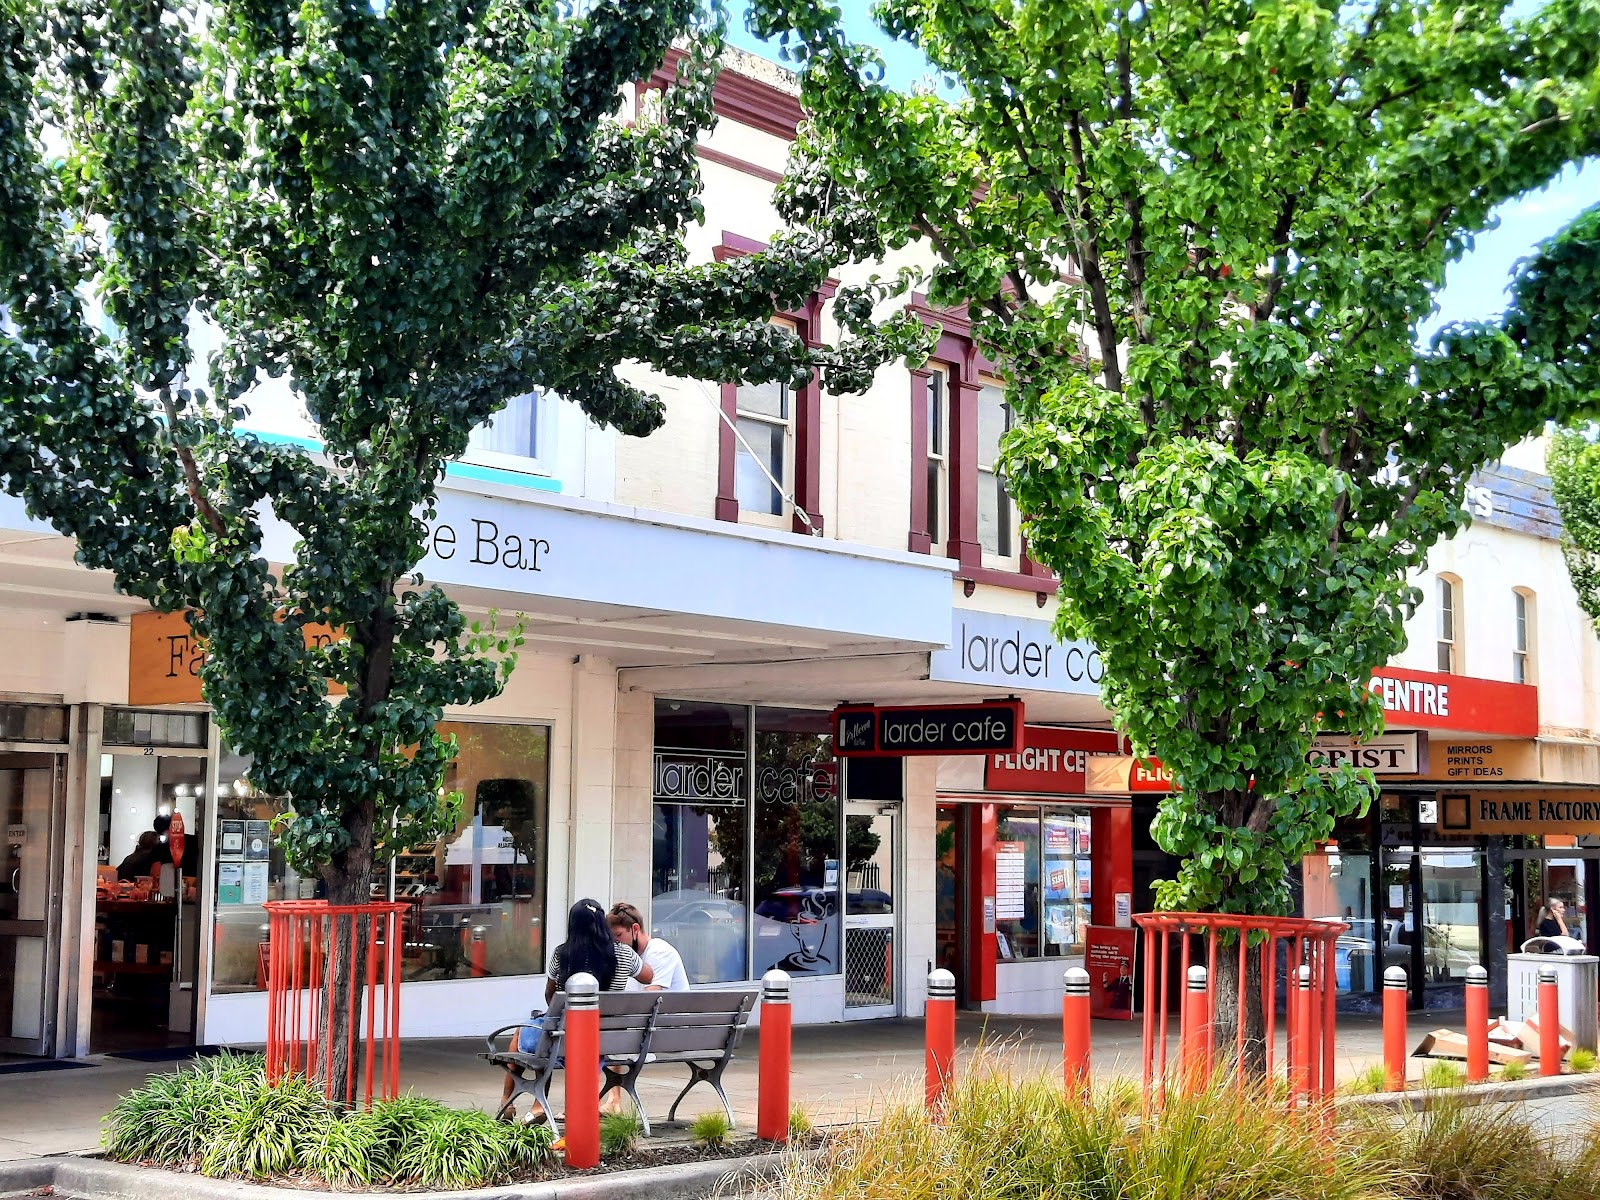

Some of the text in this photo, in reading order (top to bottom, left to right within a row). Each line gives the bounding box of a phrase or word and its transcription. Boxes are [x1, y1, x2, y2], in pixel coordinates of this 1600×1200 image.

[470, 518, 550, 571] Bar
[961, 623, 1105, 684] larder co
[884, 717, 947, 744] larder
[952, 716, 1007, 742] cafe
[143, 747, 154, 756] 22
[994, 747, 1060, 773] FLIGHT
[1447, 745, 1493, 755] MIRRORS
[1447, 756, 1483, 765] PRINTS
[655, 754, 832, 804] larder cafe
[1136, 767, 1174, 782] FLIG
[1447, 767, 1503, 777] GIFT IDEAS
[1480, 799, 1600, 821] FRAME FACTORY
